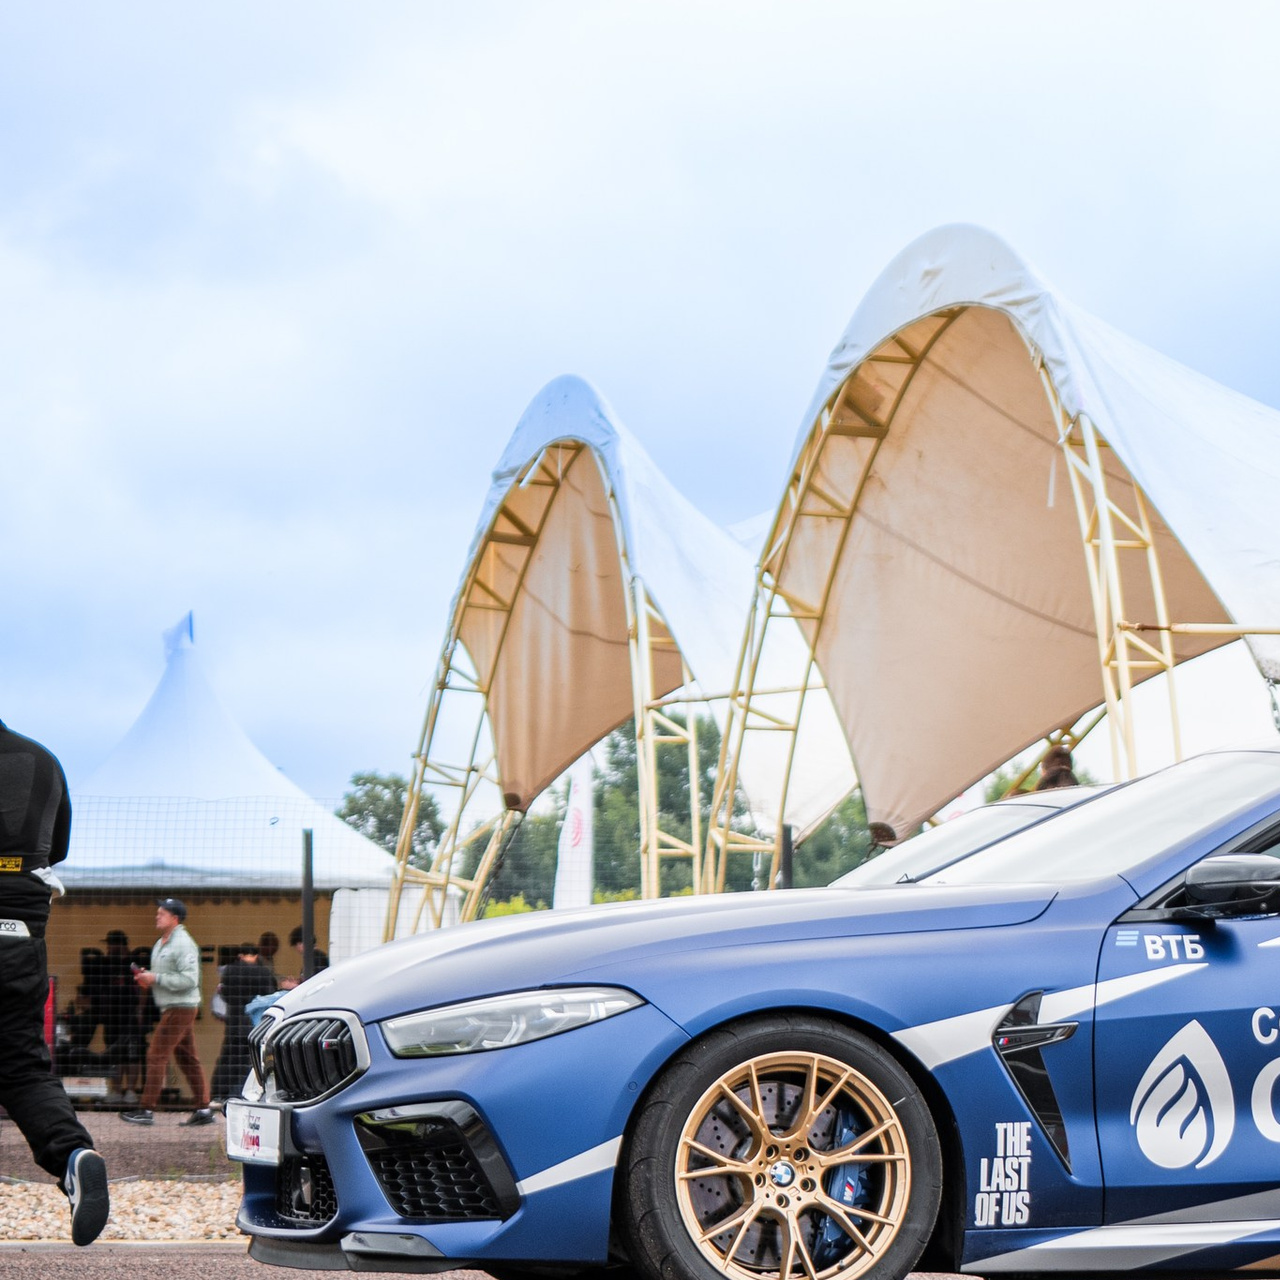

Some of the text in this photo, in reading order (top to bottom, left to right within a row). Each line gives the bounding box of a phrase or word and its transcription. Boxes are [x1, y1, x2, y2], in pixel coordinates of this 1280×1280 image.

[1143, 934, 1205, 960] ВТБ
[995, 1122, 1032, 1157] THE
[980, 1157, 1031, 1192] LAST
[974, 1191, 1031, 1227] OF US
